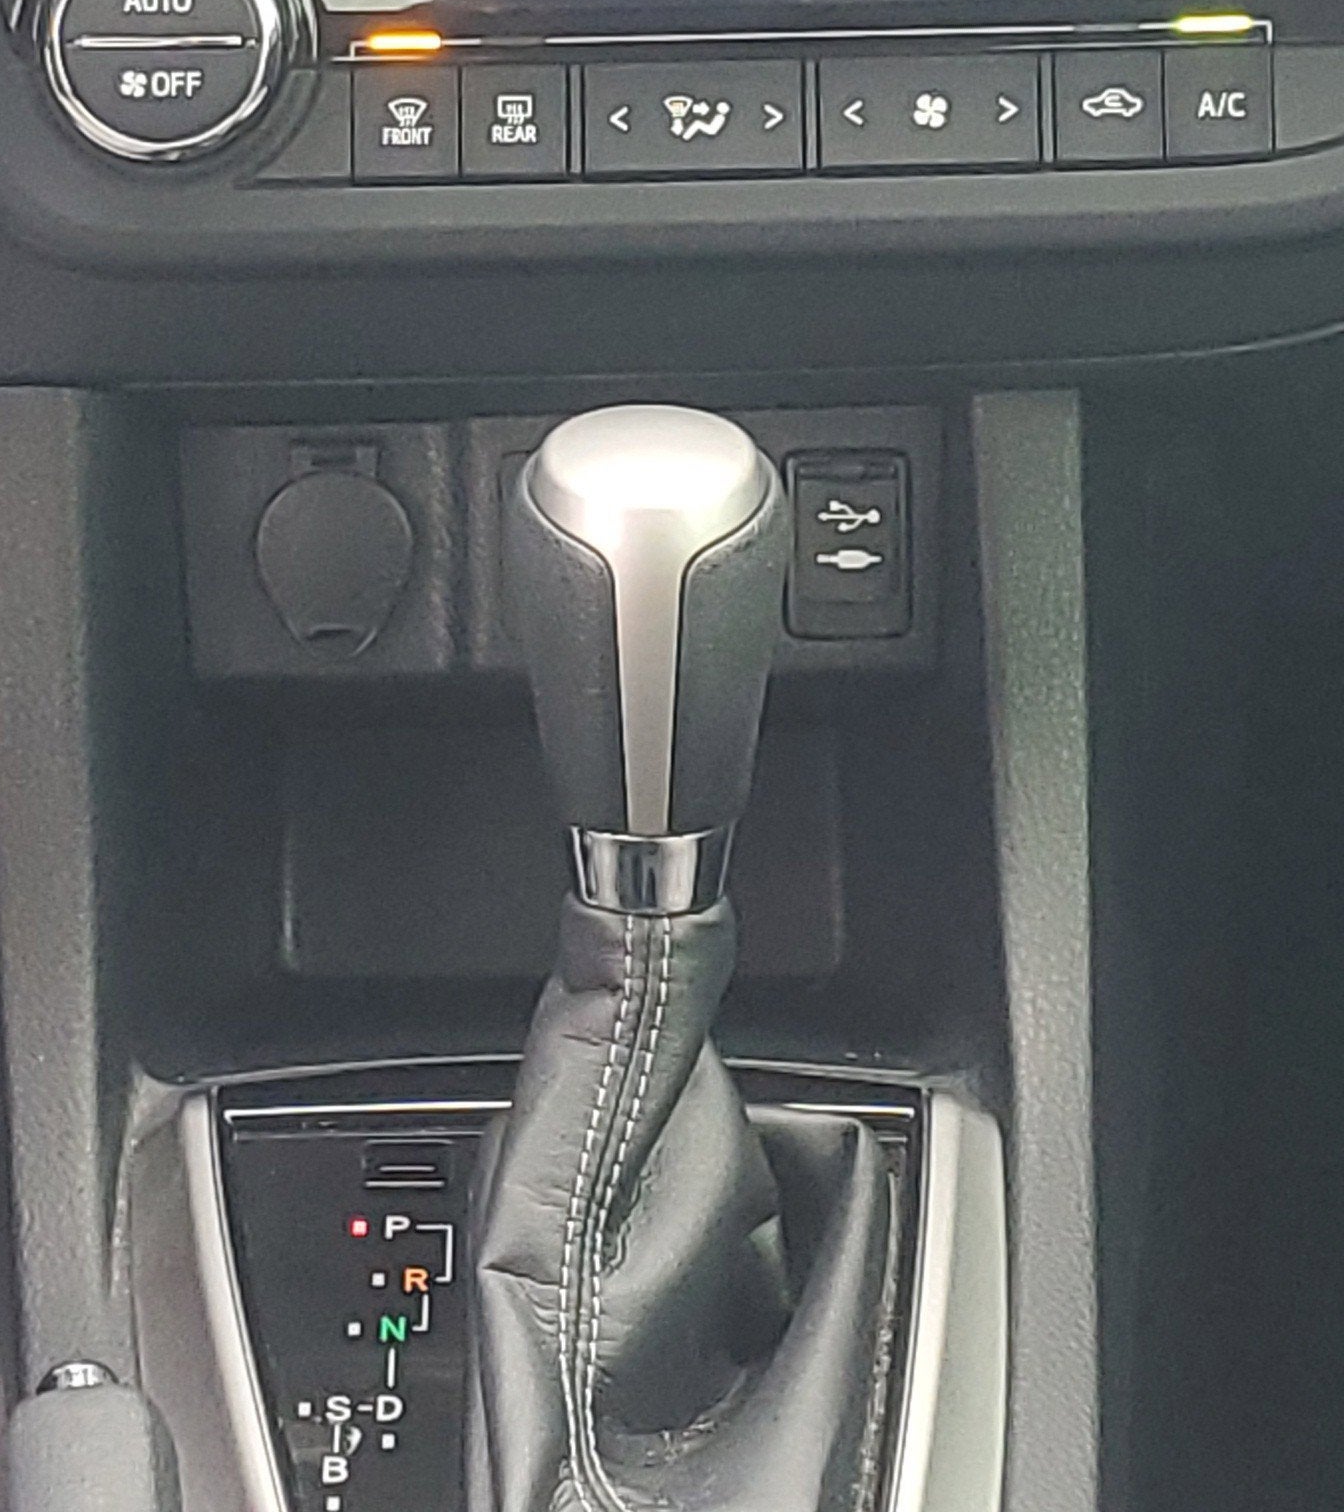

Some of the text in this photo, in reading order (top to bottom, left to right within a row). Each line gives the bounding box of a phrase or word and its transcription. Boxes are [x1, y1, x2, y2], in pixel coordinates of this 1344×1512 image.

[151, 71, 202, 97] OFF
[1197, 92, 1246, 118] A/C
[382, 126, 432, 146] FRONT
[491, 125, 537, 144] REAR
[385, 1215, 411, 1239] P
[404, 1267, 428, 1292] R
[380, 1316, 406, 1342] N
[322, 1455, 349, 1484] B
